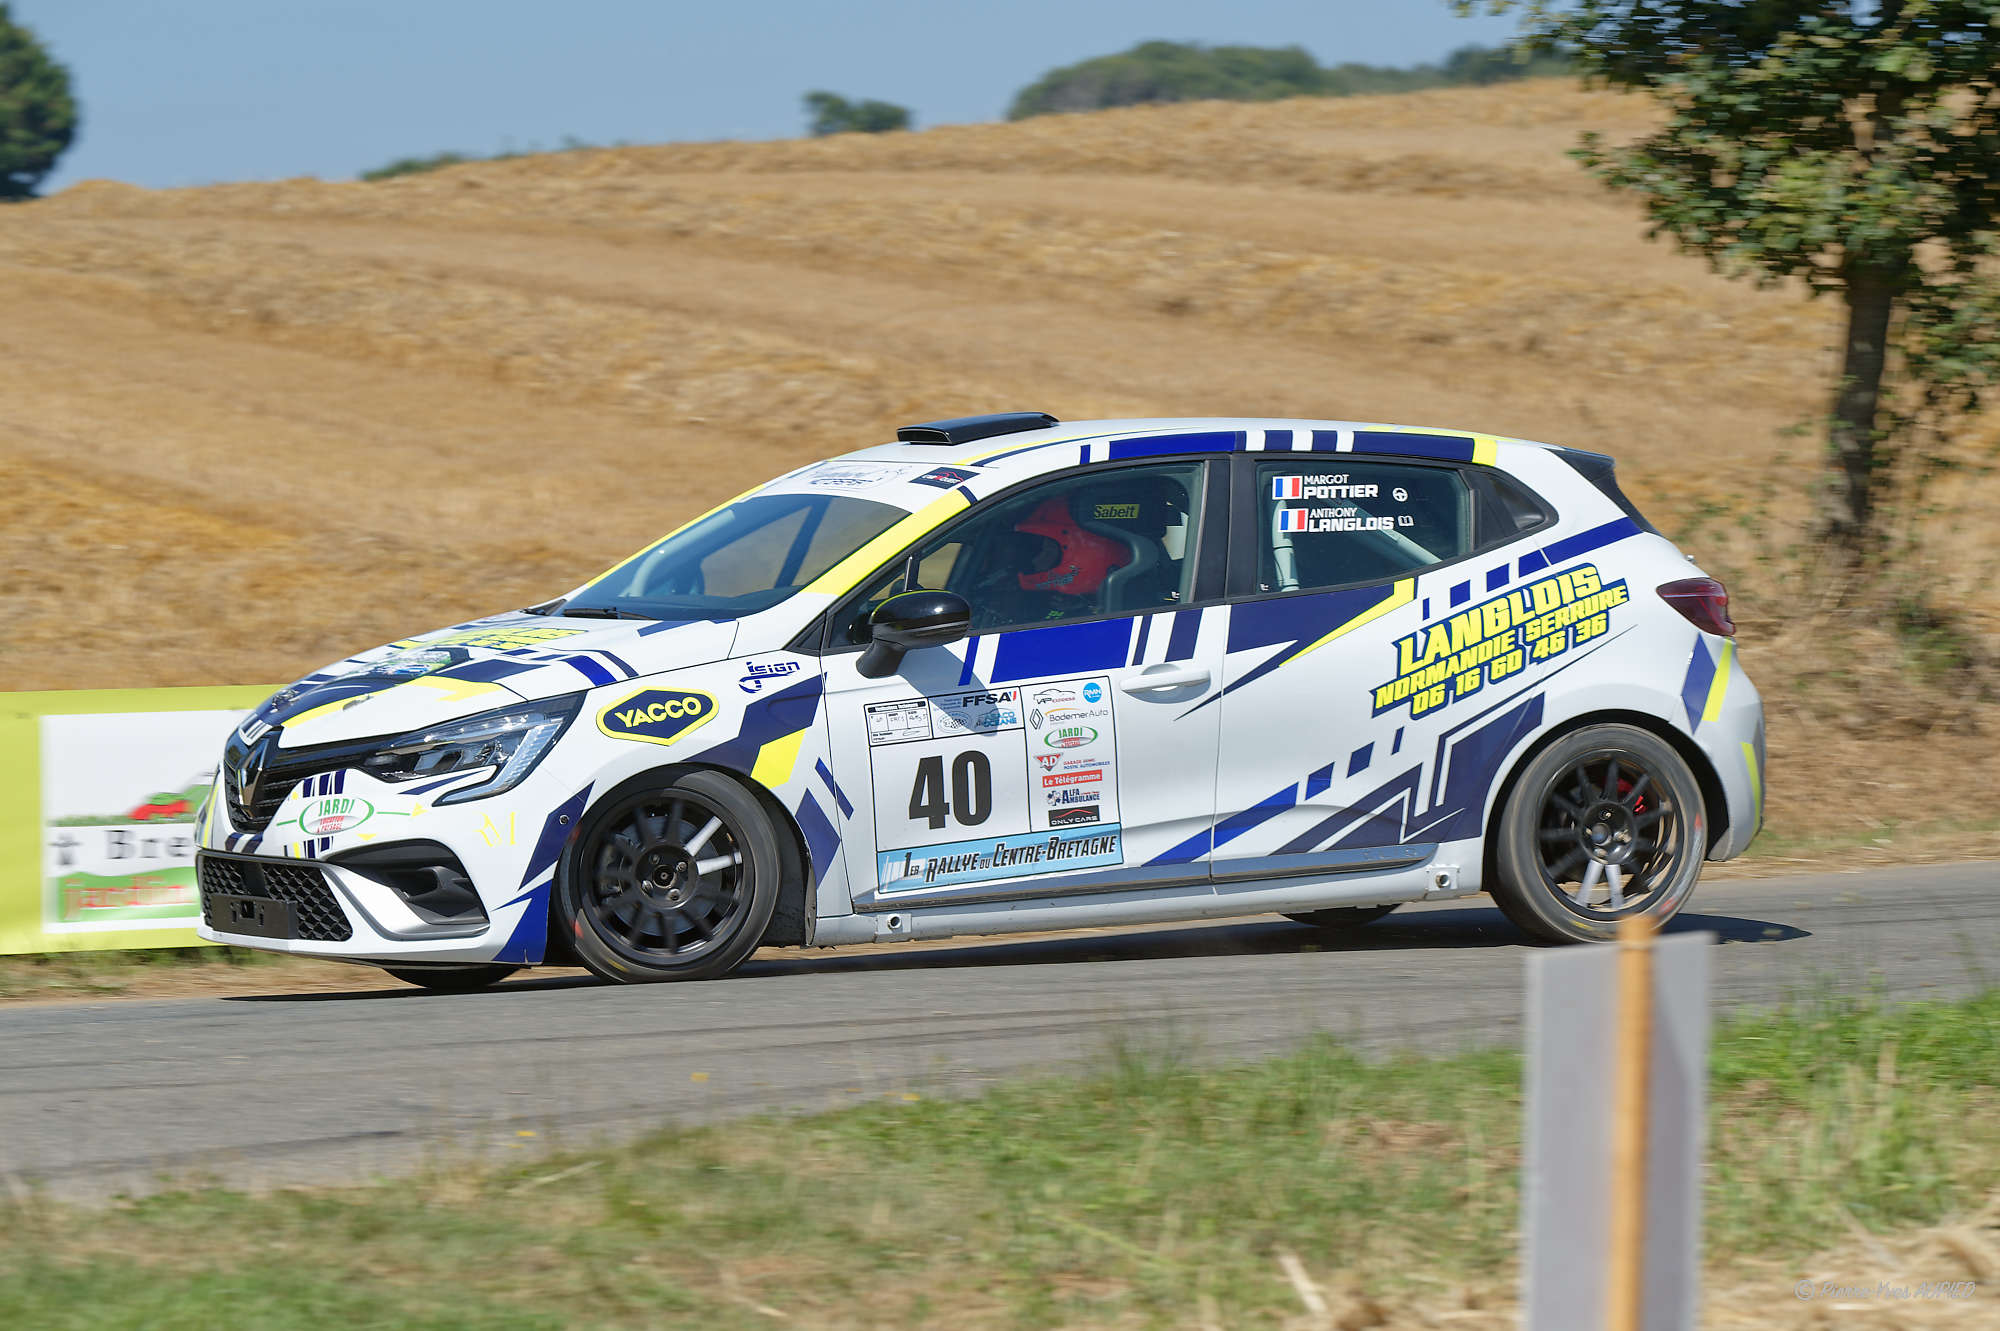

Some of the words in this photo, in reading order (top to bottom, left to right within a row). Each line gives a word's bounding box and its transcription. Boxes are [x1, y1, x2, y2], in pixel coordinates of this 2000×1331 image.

[1304, 475, 1349, 484] MARGOT
[1304, 485, 1378, 499] POTTIER
[1095, 505, 1135, 518] Sabelt
[1310, 508, 1357, 518] ANTHONY
[1309, 517, 1394, 532] LANGLOIS
[1398, 566, 1602, 676] LANGLOIS
[1375, 629, 1518, 709] NORMANDIE
[1525, 585, 1628, 642] SERRURE
[1411, 686, 1446, 715] 06
[1455, 668, 1481, 696] 16
[1490, 649, 1523, 681] 60
[1531, 632, 1566, 660] 46
[1575, 613, 1608, 644] 36
[962, 692, 1012, 708] FFSA
[614, 696, 702, 728] YACCO
[1058, 727, 1083, 738] JARDI
[1041, 757, 1058, 768] AD
[1044, 778, 1053, 786] Le
[1054, 773, 1101, 785] Télégramme
[909, 750, 993, 830] 40
[318, 799, 354, 816] JARDI
[1051, 818, 1073, 826] ONLY
[926, 853, 979, 882] RALLYE
[979, 858, 992, 870] DU
[992, 835, 1118, 868] CENTRE-BRETAGNE
